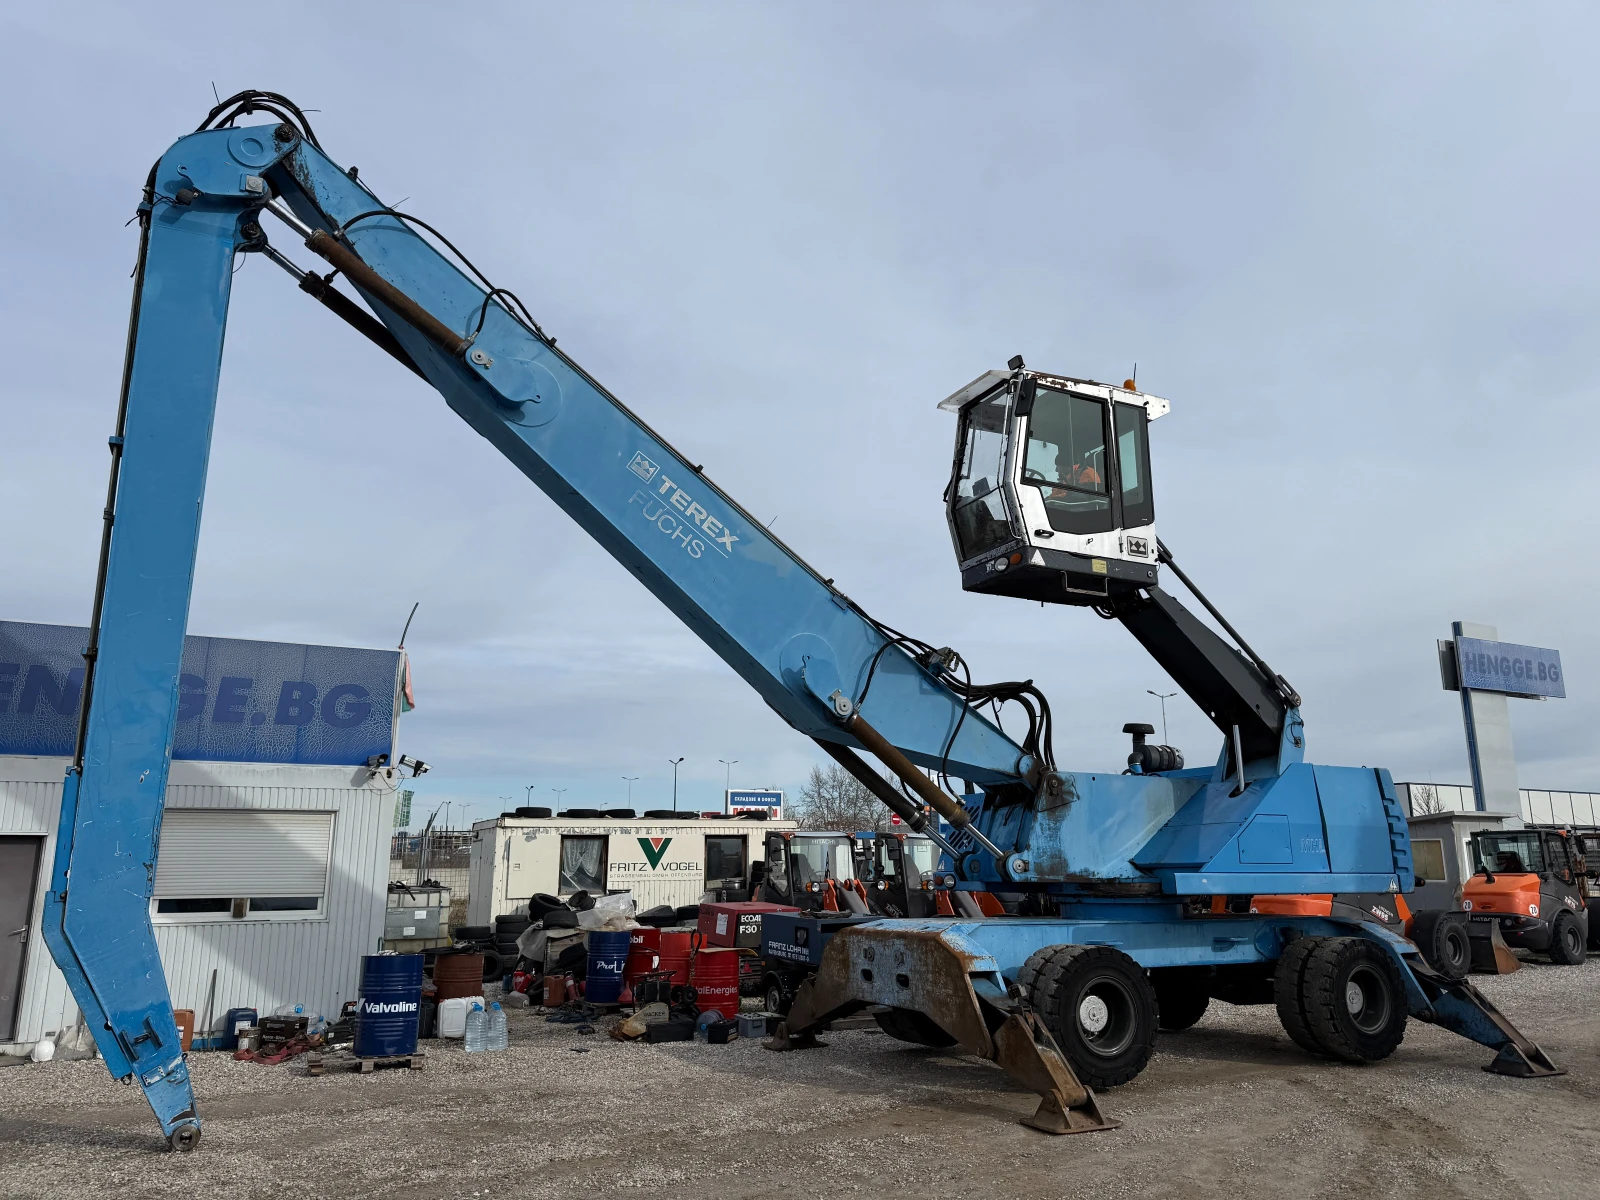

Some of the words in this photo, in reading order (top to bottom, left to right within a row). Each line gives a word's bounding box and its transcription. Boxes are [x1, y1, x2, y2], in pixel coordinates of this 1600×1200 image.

[659, 475, 740, 553] TEREX
[628, 489, 705, 559] FUCHS
[1464, 651, 1560, 683] HENGGE.BG
[609, 862, 648, 872] FRITZ
[660, 861, 703, 872] VOGEL
[1464, 901, 1471, 909] 20
[1530, 905, 1538, 915] 20
[740, 915, 761, 923] ECOAI
[740, 925, 758, 934] F30
[768, 940, 787, 951] FRANZ
[365, 1001, 418, 1015] Valvoline
